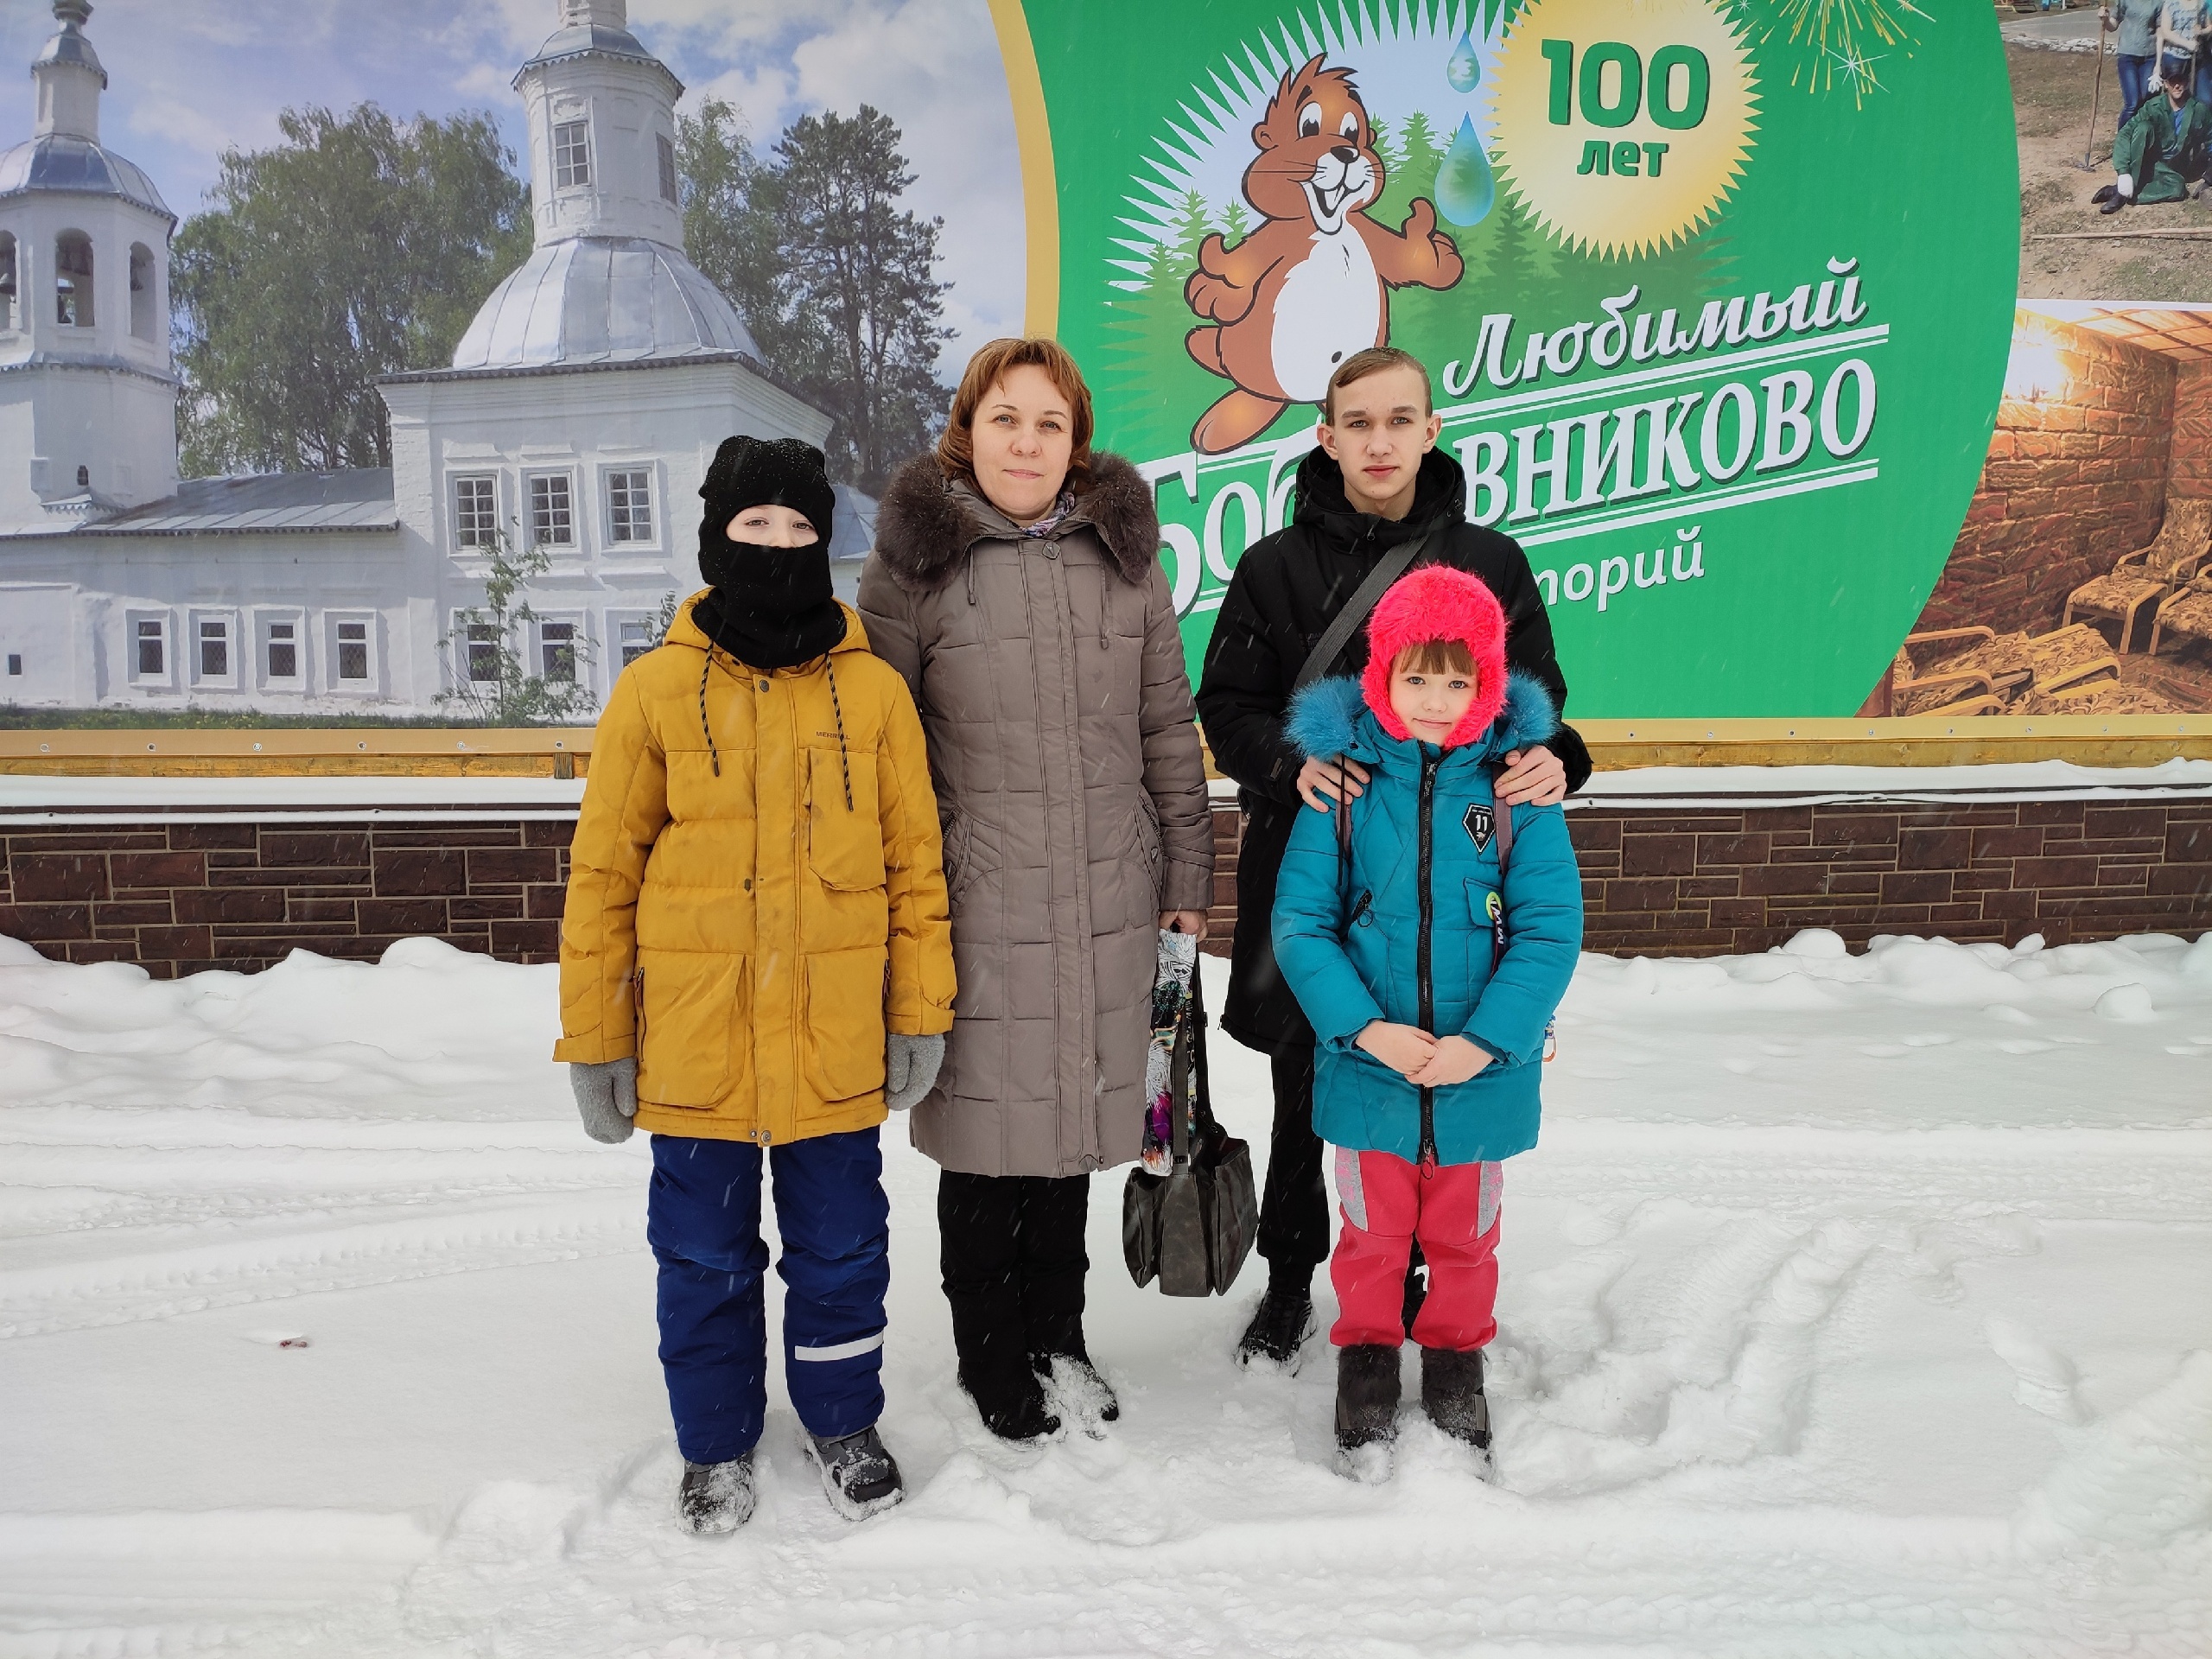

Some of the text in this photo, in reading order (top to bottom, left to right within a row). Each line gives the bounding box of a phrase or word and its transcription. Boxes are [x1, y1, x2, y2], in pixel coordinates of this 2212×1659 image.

[1541, 39, 1710, 130] 100
[1577, 140, 1669, 177] лет
[1442, 256, 1869, 398] Любимый
[816, 731, 851, 741] MERRL
